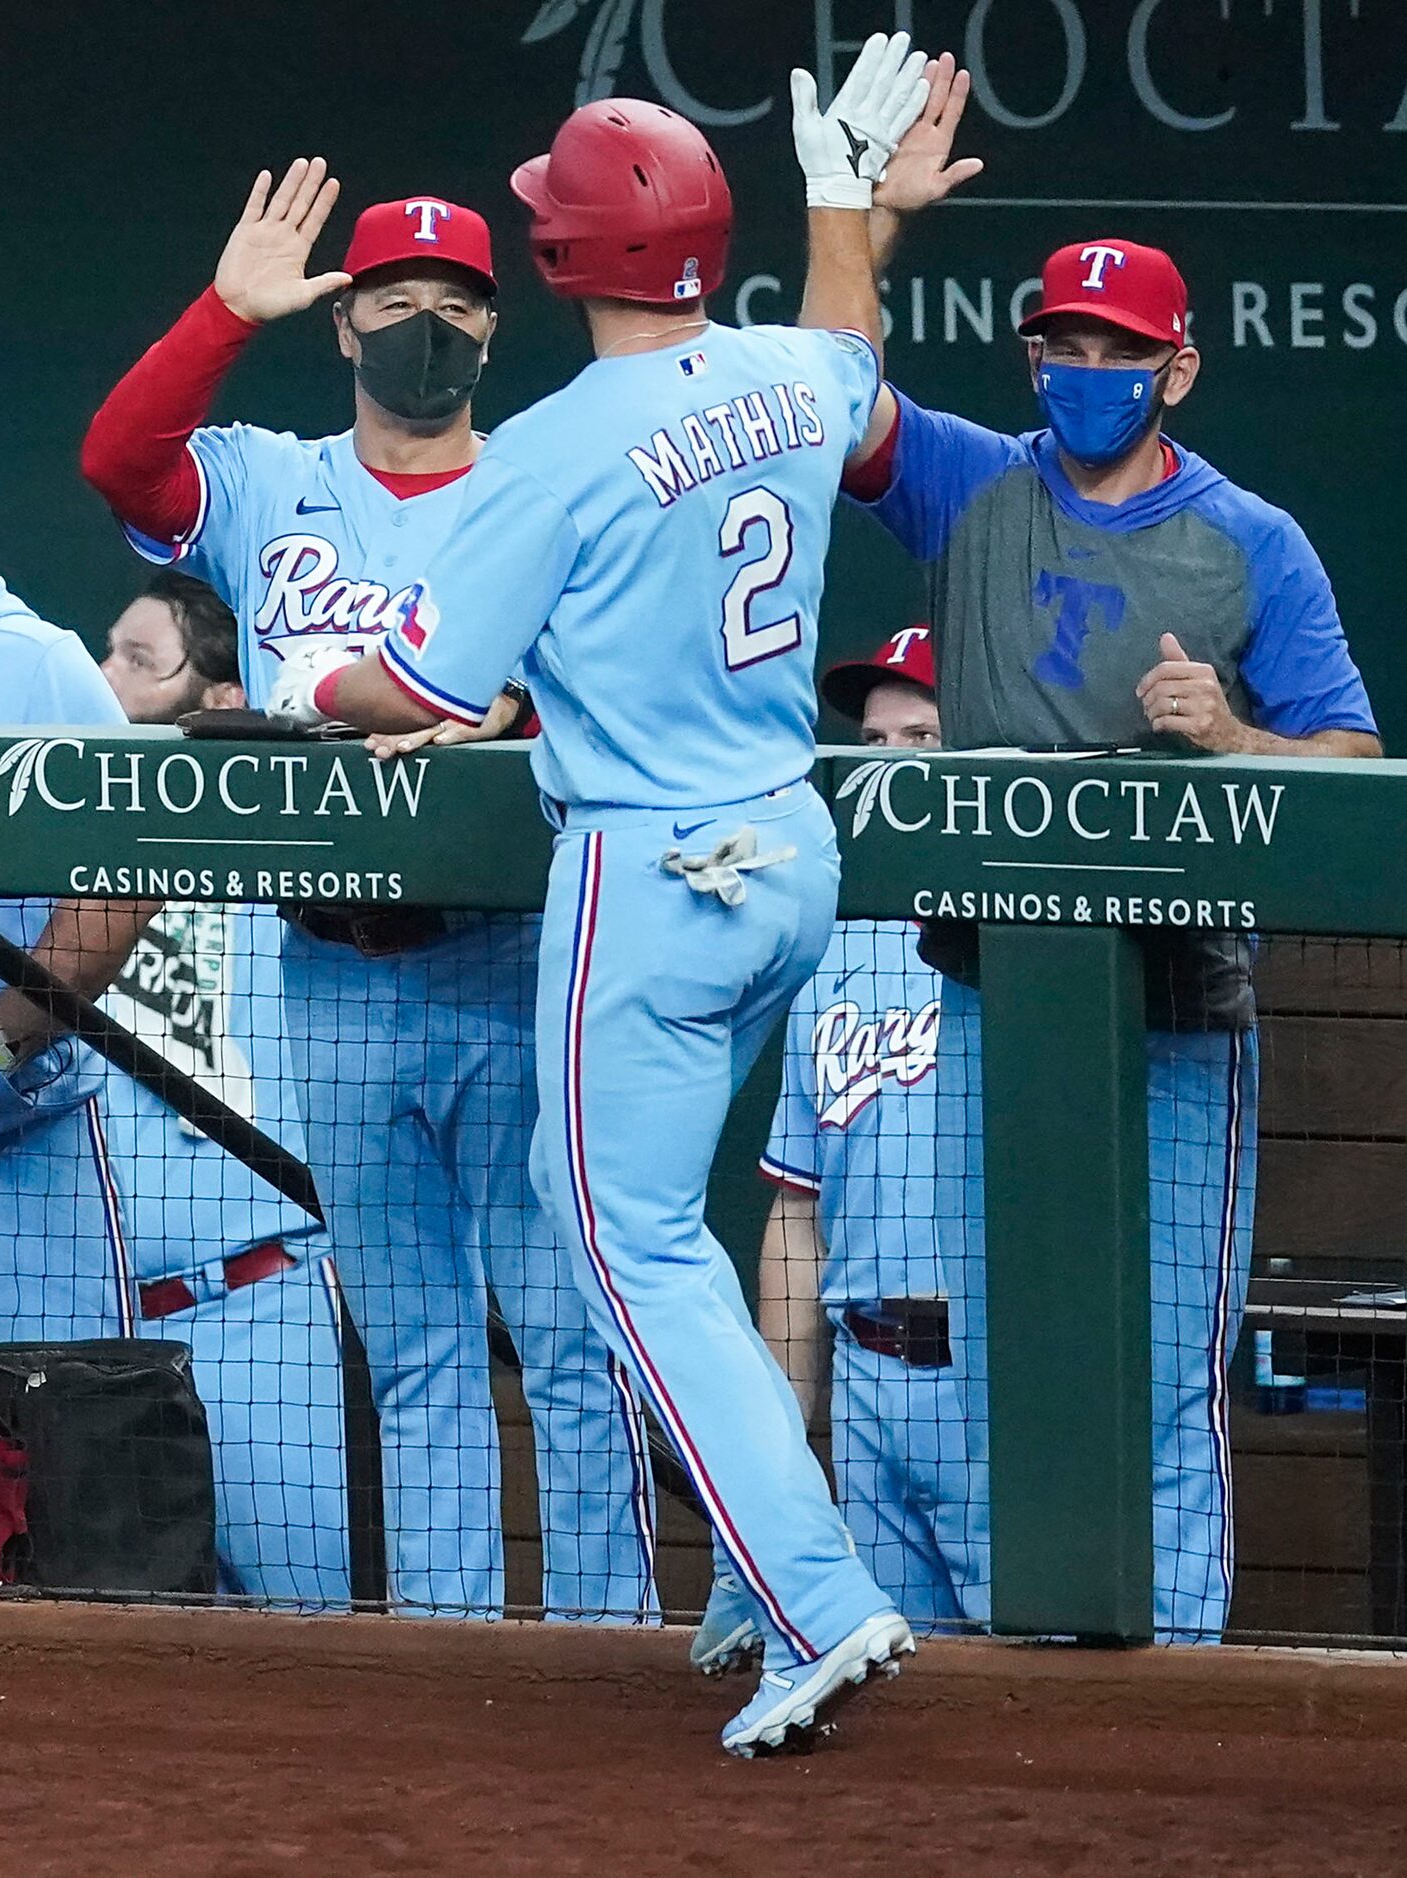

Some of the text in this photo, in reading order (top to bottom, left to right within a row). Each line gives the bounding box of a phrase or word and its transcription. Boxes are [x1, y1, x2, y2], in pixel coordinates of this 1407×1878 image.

[405, 200, 451, 243] T
[1080, 246, 1126, 292] T
[1132, 382, 1144, 400] 8
[626, 381, 825, 508] MATHIS
[718, 484, 802, 672] 2
[886, 626, 930, 664] T
[1034, 567, 1126, 689] T
[34, 738, 431, 818] CHOCTAW
[879, 760, 1286, 846] CHOCTAW
[69, 866, 404, 900] CASINOS & RESORTS
[913, 890, 1257, 929] CASINOS & RESORTS
